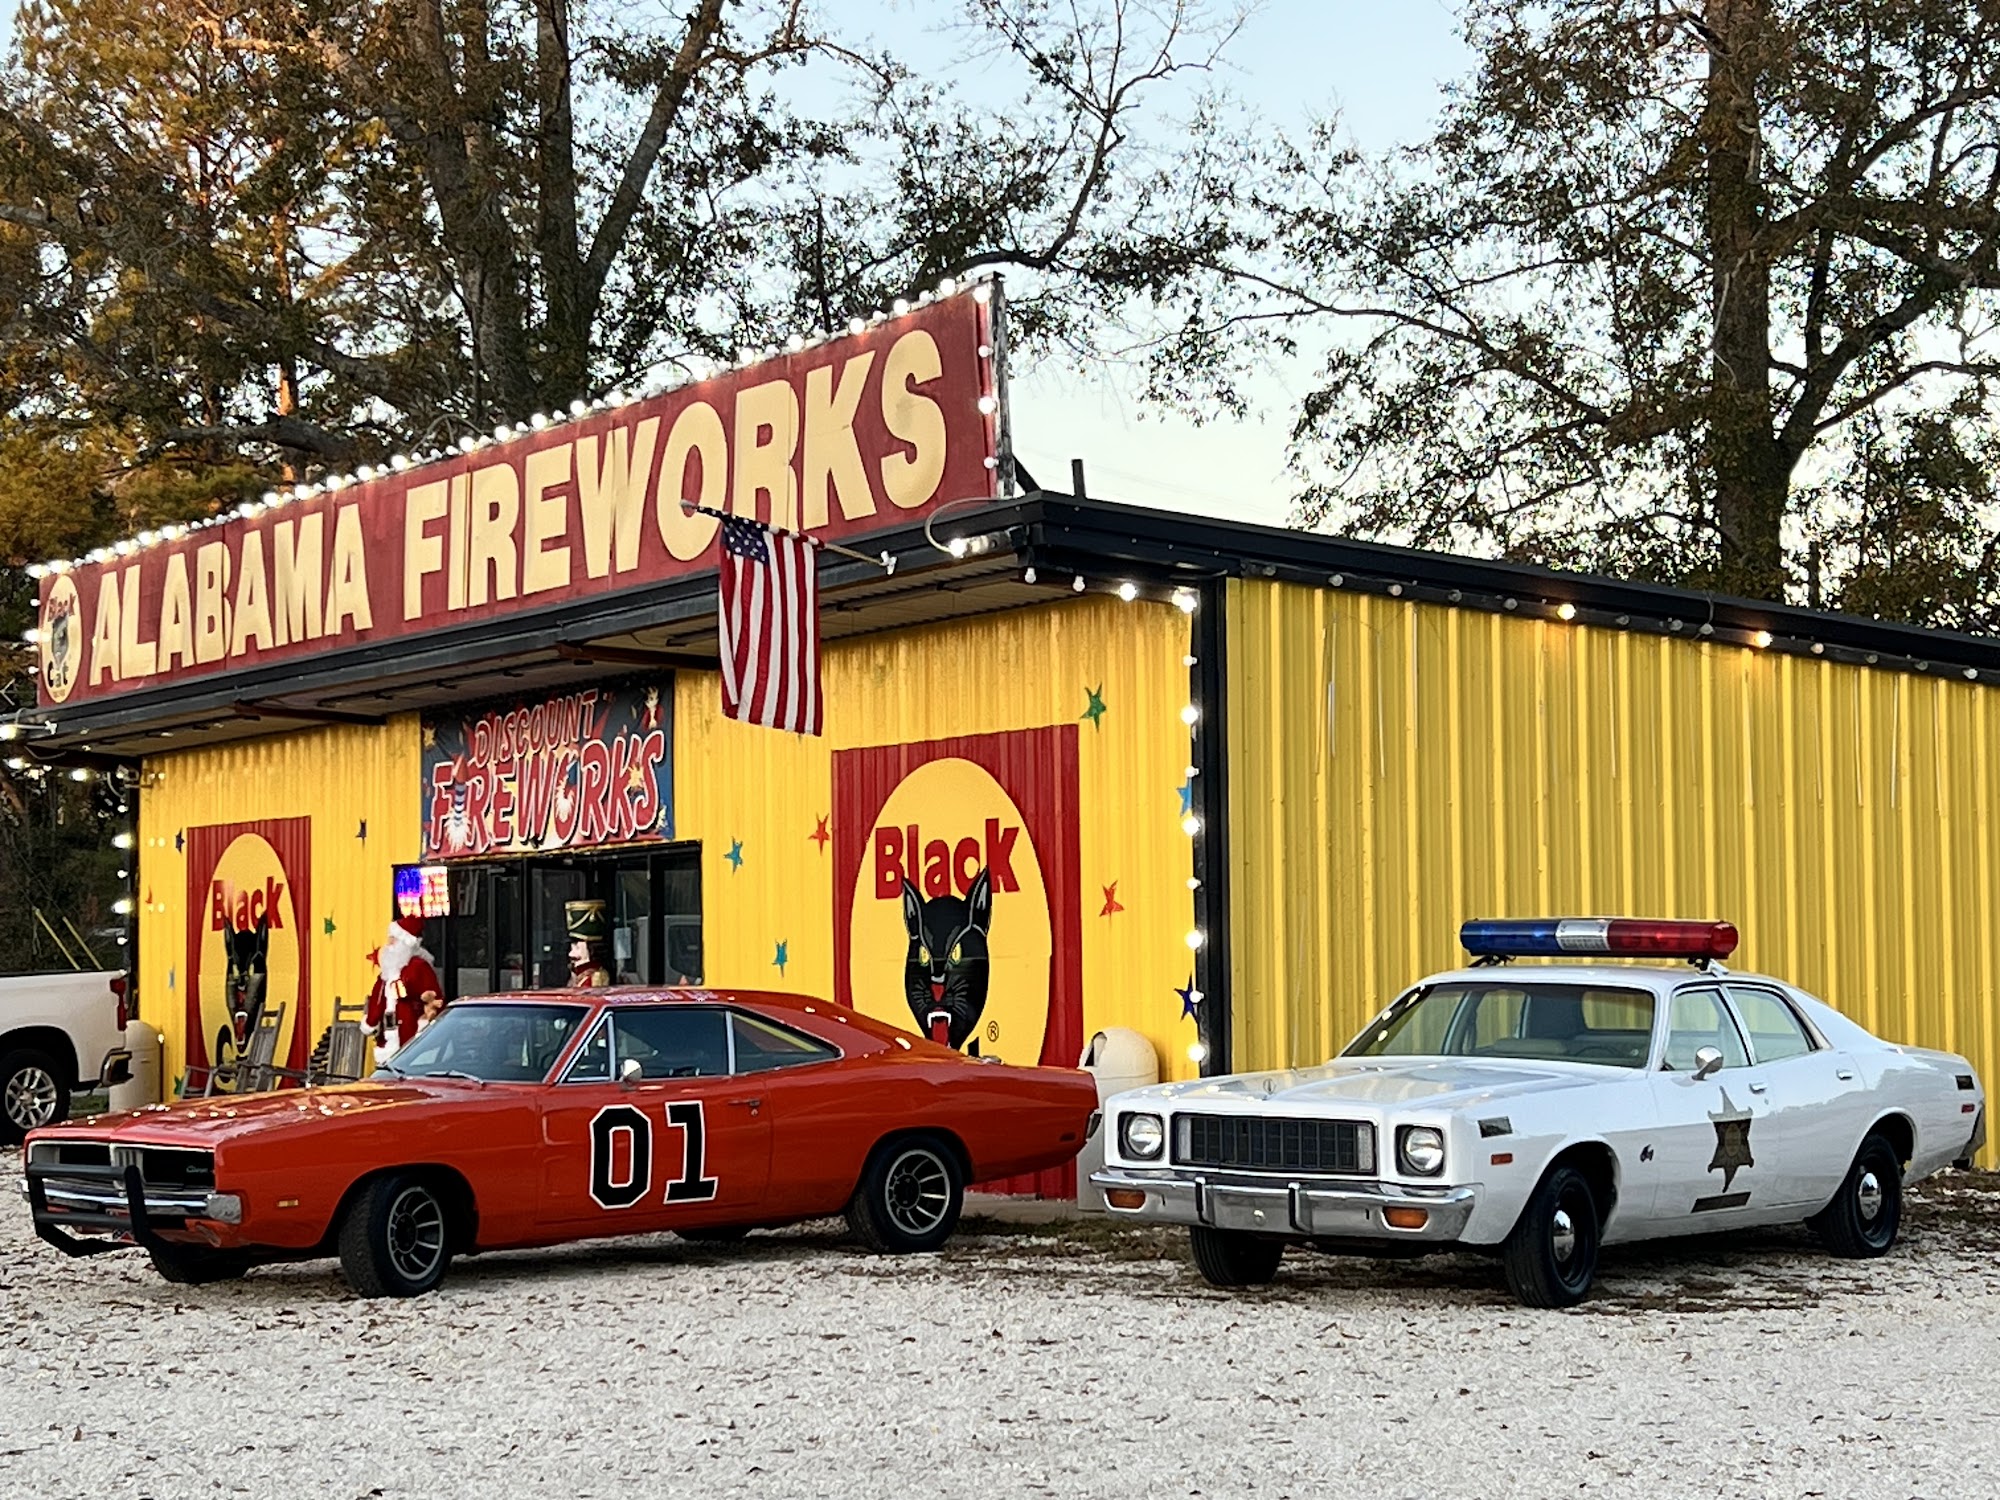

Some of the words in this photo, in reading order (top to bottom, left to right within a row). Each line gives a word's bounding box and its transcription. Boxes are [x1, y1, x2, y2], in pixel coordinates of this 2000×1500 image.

[89, 503, 374, 687] ALABAMA
[403, 328, 947, 622] FIREWORKS
[468, 688, 599, 769] DISCOUNT
[875, 818, 1021, 899] Black
[211, 876, 284, 932] Black
[589, 1100, 718, 1209] 01
